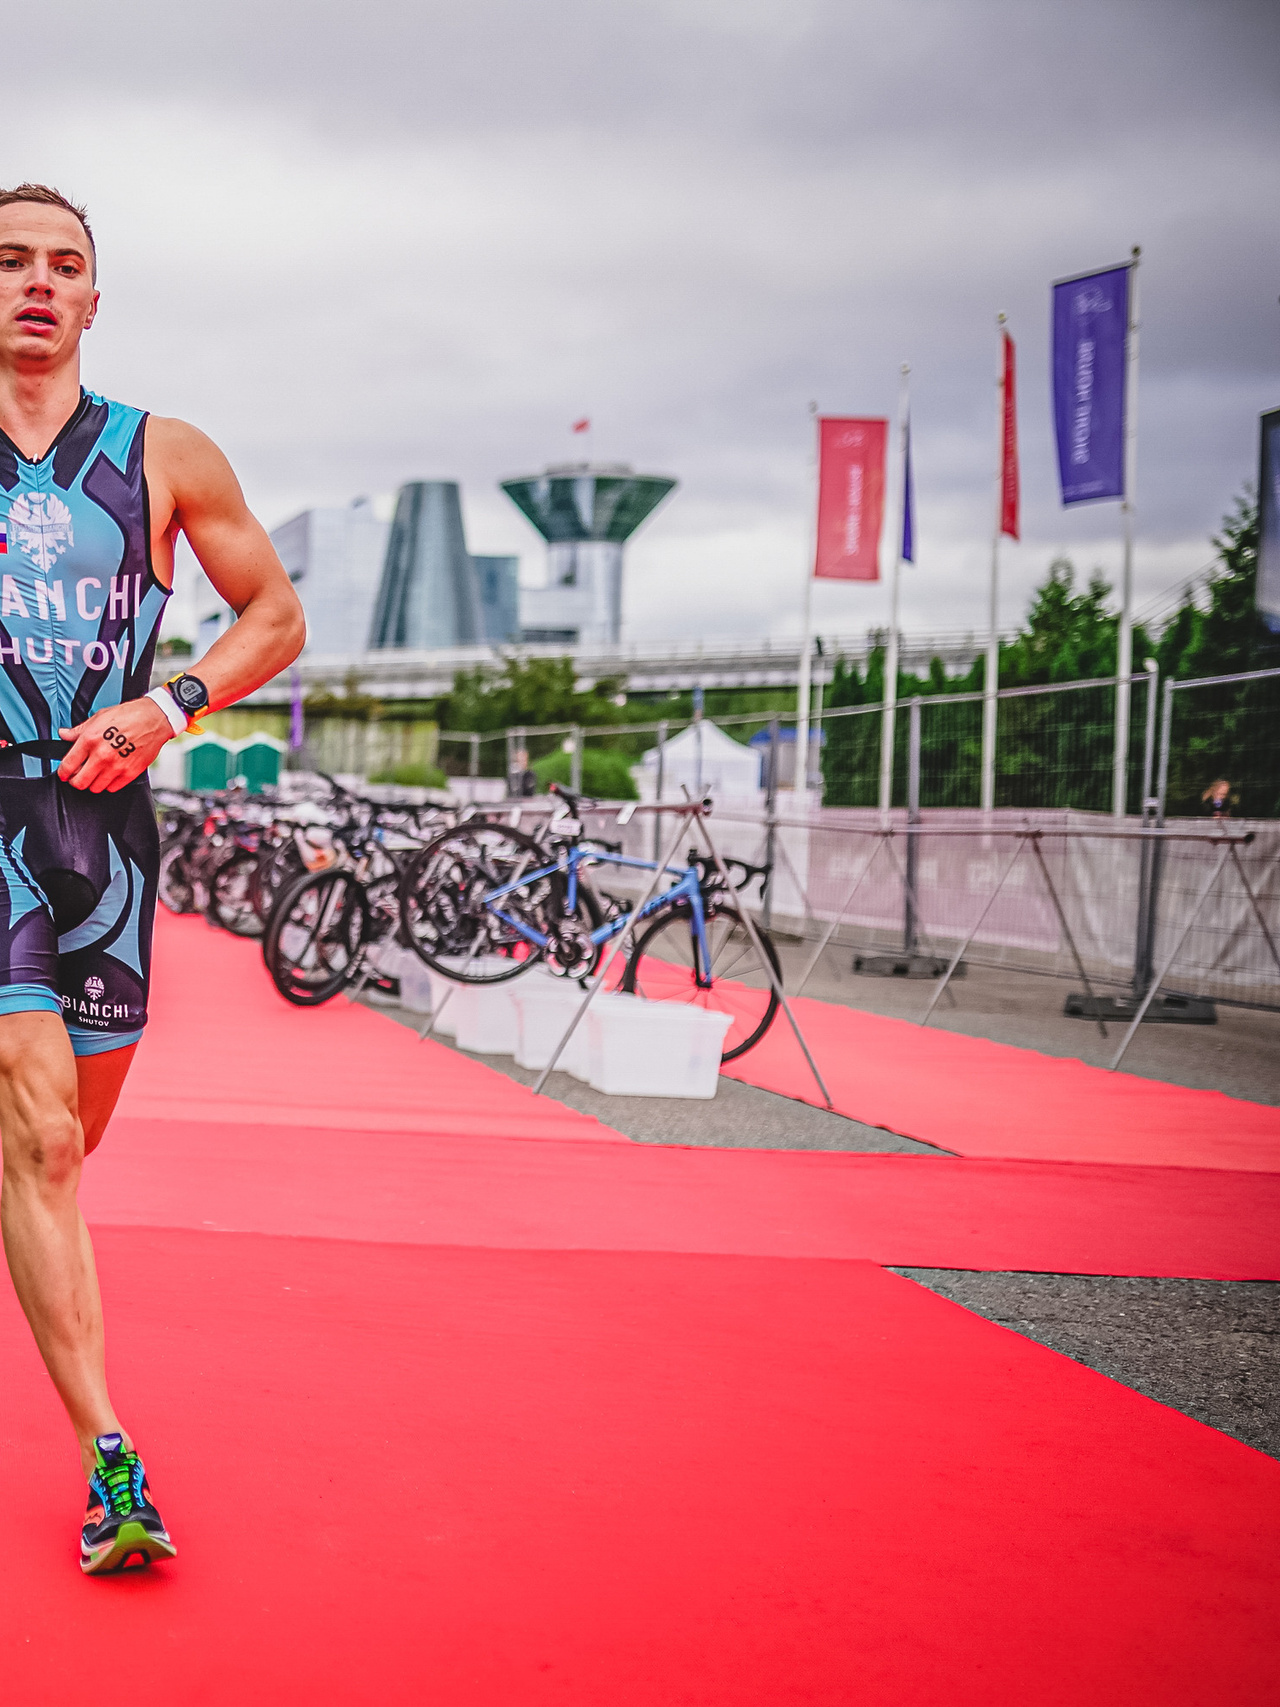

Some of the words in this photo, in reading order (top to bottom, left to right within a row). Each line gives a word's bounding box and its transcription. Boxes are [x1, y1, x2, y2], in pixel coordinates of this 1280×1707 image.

[102, 726, 136, 758] 693
[62, 995, 129, 1018] BIANCHI
[79, 1016, 109, 1027] SHUTOV
